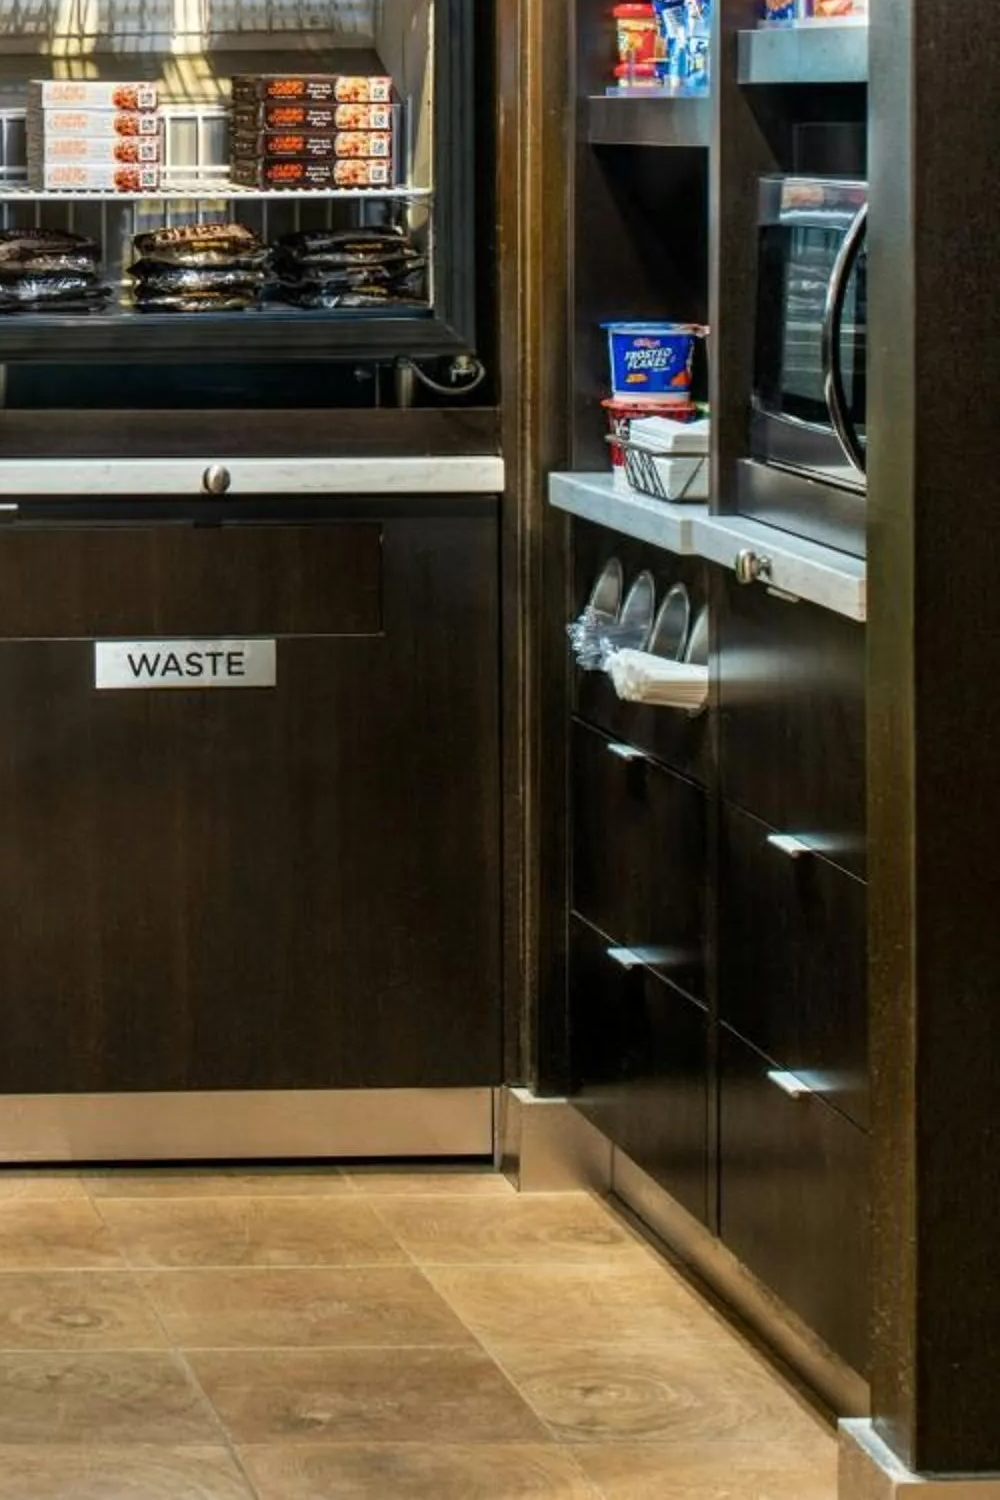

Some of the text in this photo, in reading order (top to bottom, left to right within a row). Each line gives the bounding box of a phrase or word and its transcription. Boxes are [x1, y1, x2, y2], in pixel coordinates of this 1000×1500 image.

[624, 347, 673, 361] FROSTED
[627, 357, 667, 371] FLAKES
[127, 651, 246, 678] WASTE
